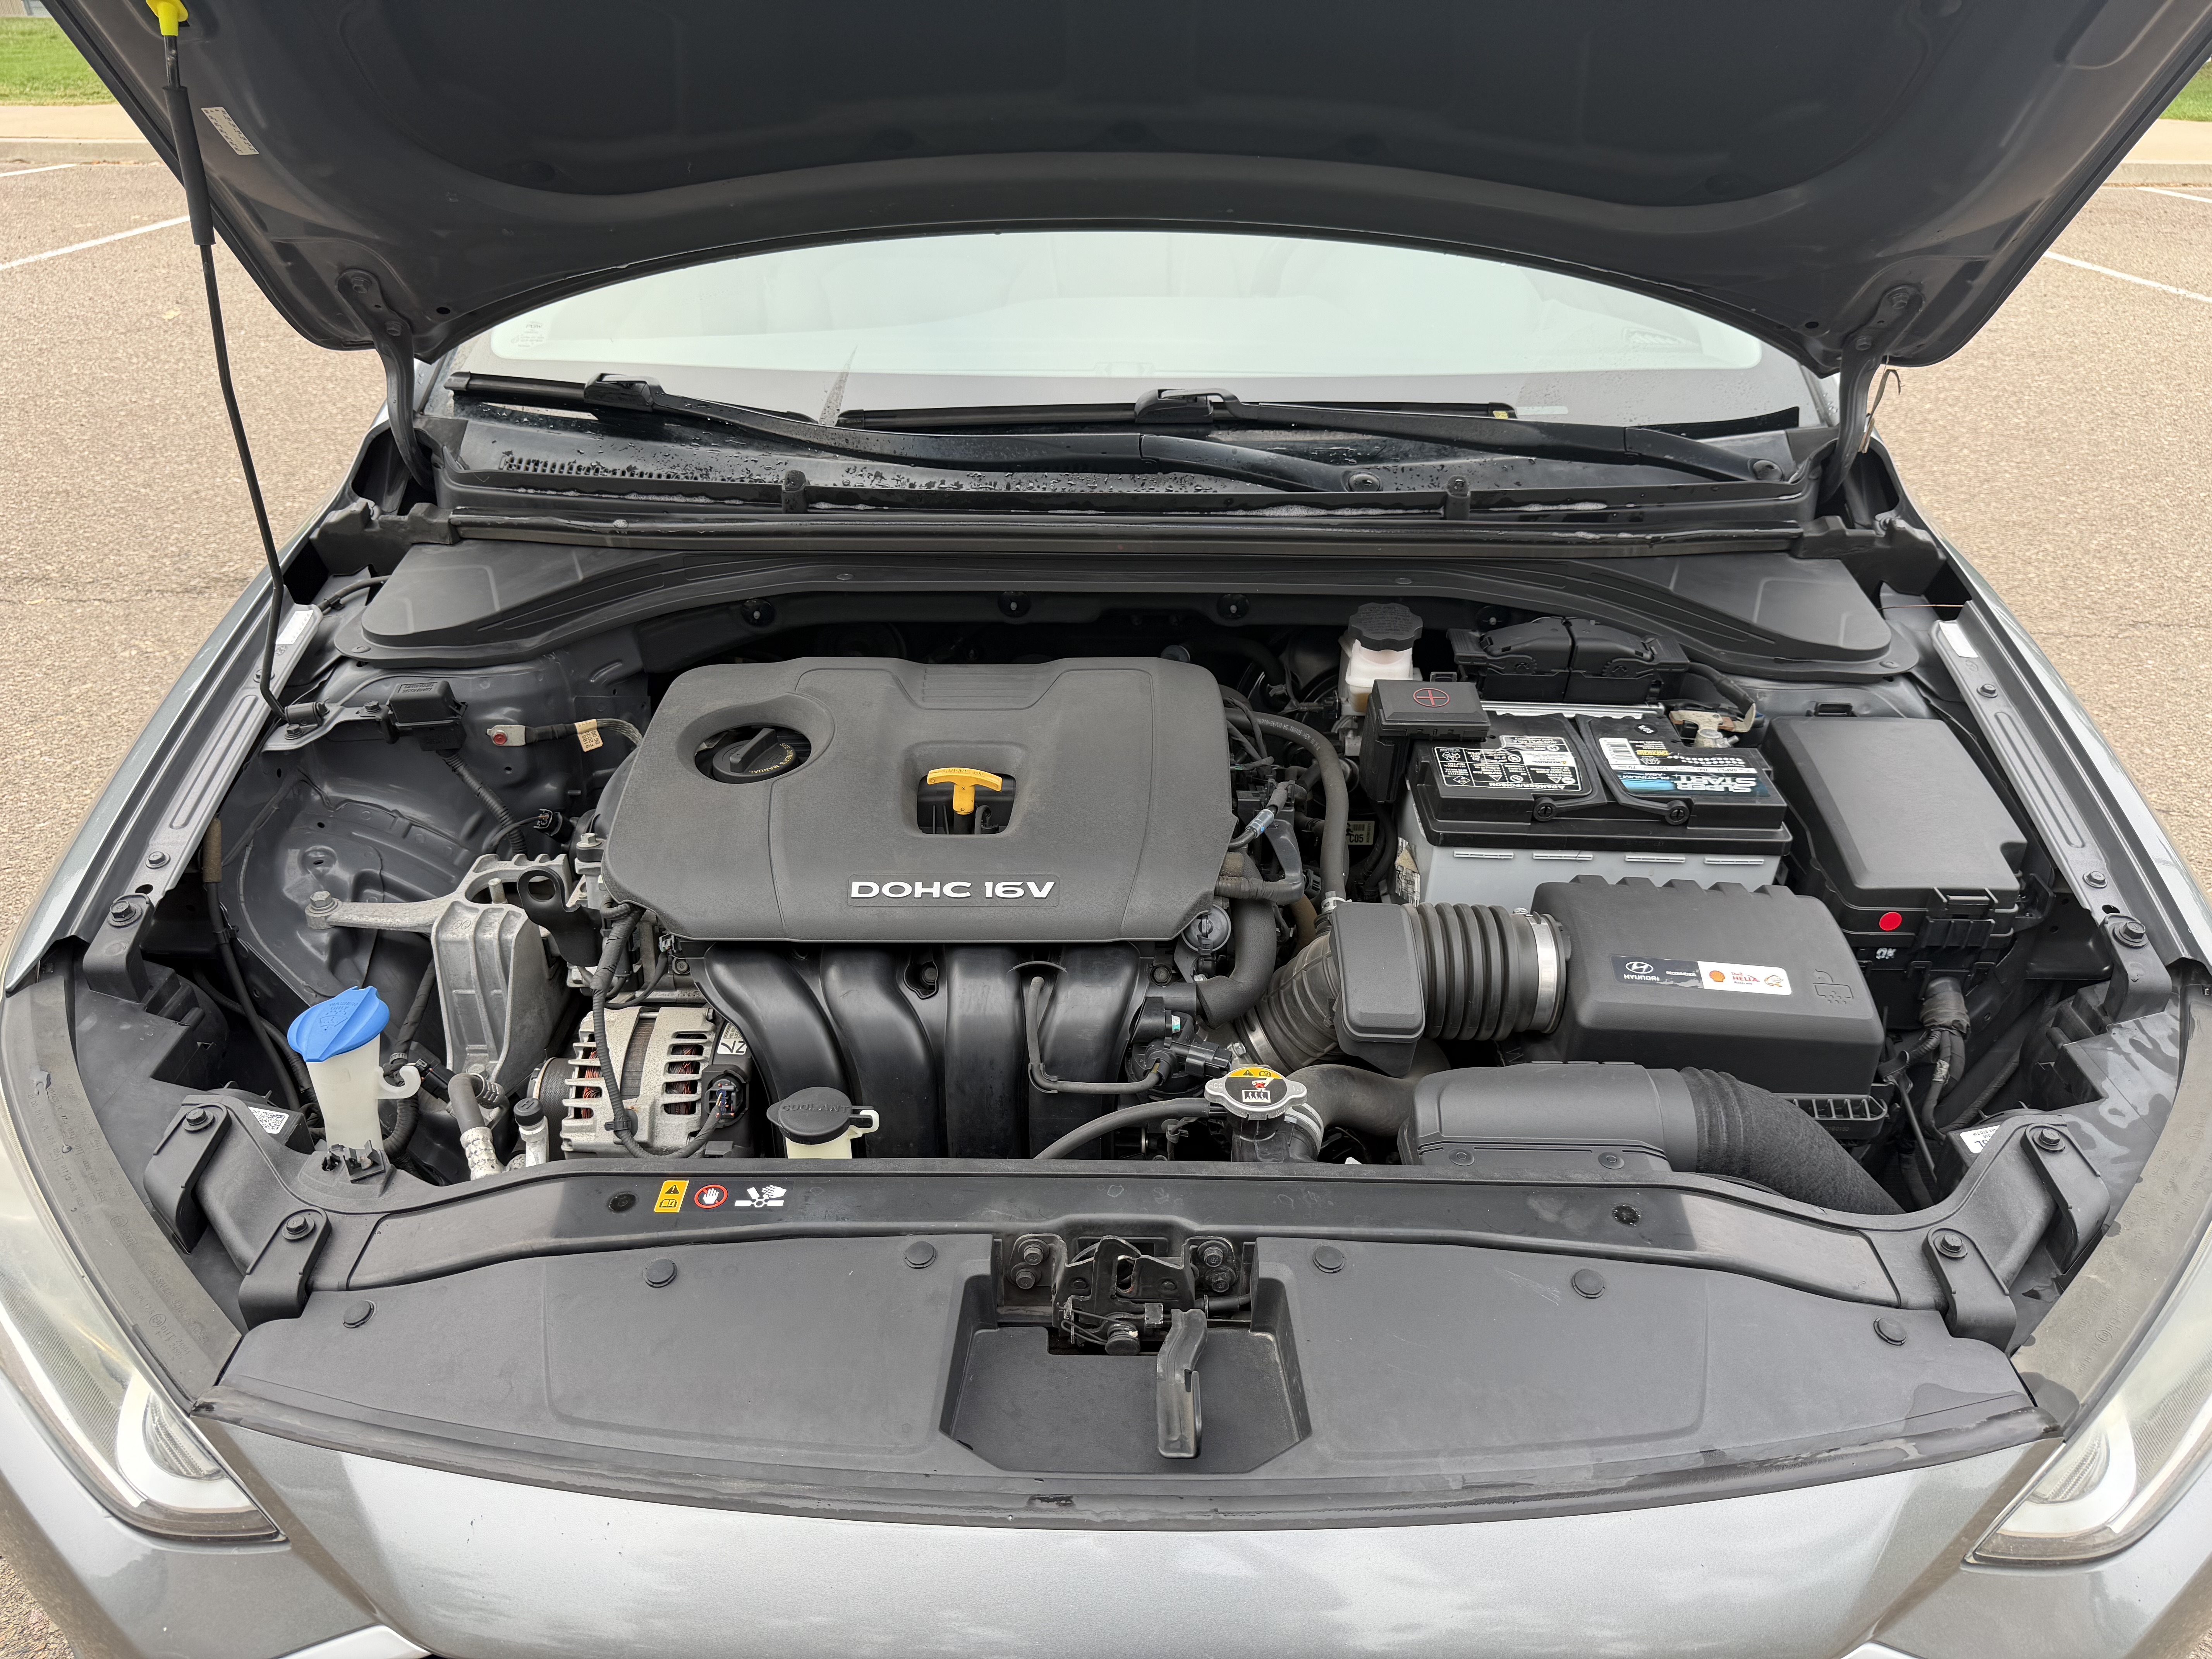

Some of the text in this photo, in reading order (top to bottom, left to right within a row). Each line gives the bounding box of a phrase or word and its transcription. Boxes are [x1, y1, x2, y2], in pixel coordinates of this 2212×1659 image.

[749, 764, 780, 774] MANUAL
[1674, 775, 1756, 787] START
[1676, 783, 1752, 793] SUPER
[851, 881, 1055, 899] DOHC 16V
[1876, 947, 1896, 959] OK
[1732, 974, 1760, 982] HELIX
[521, 1100, 534, 1109] H
[781, 1103, 849, 1113] COOLANT
